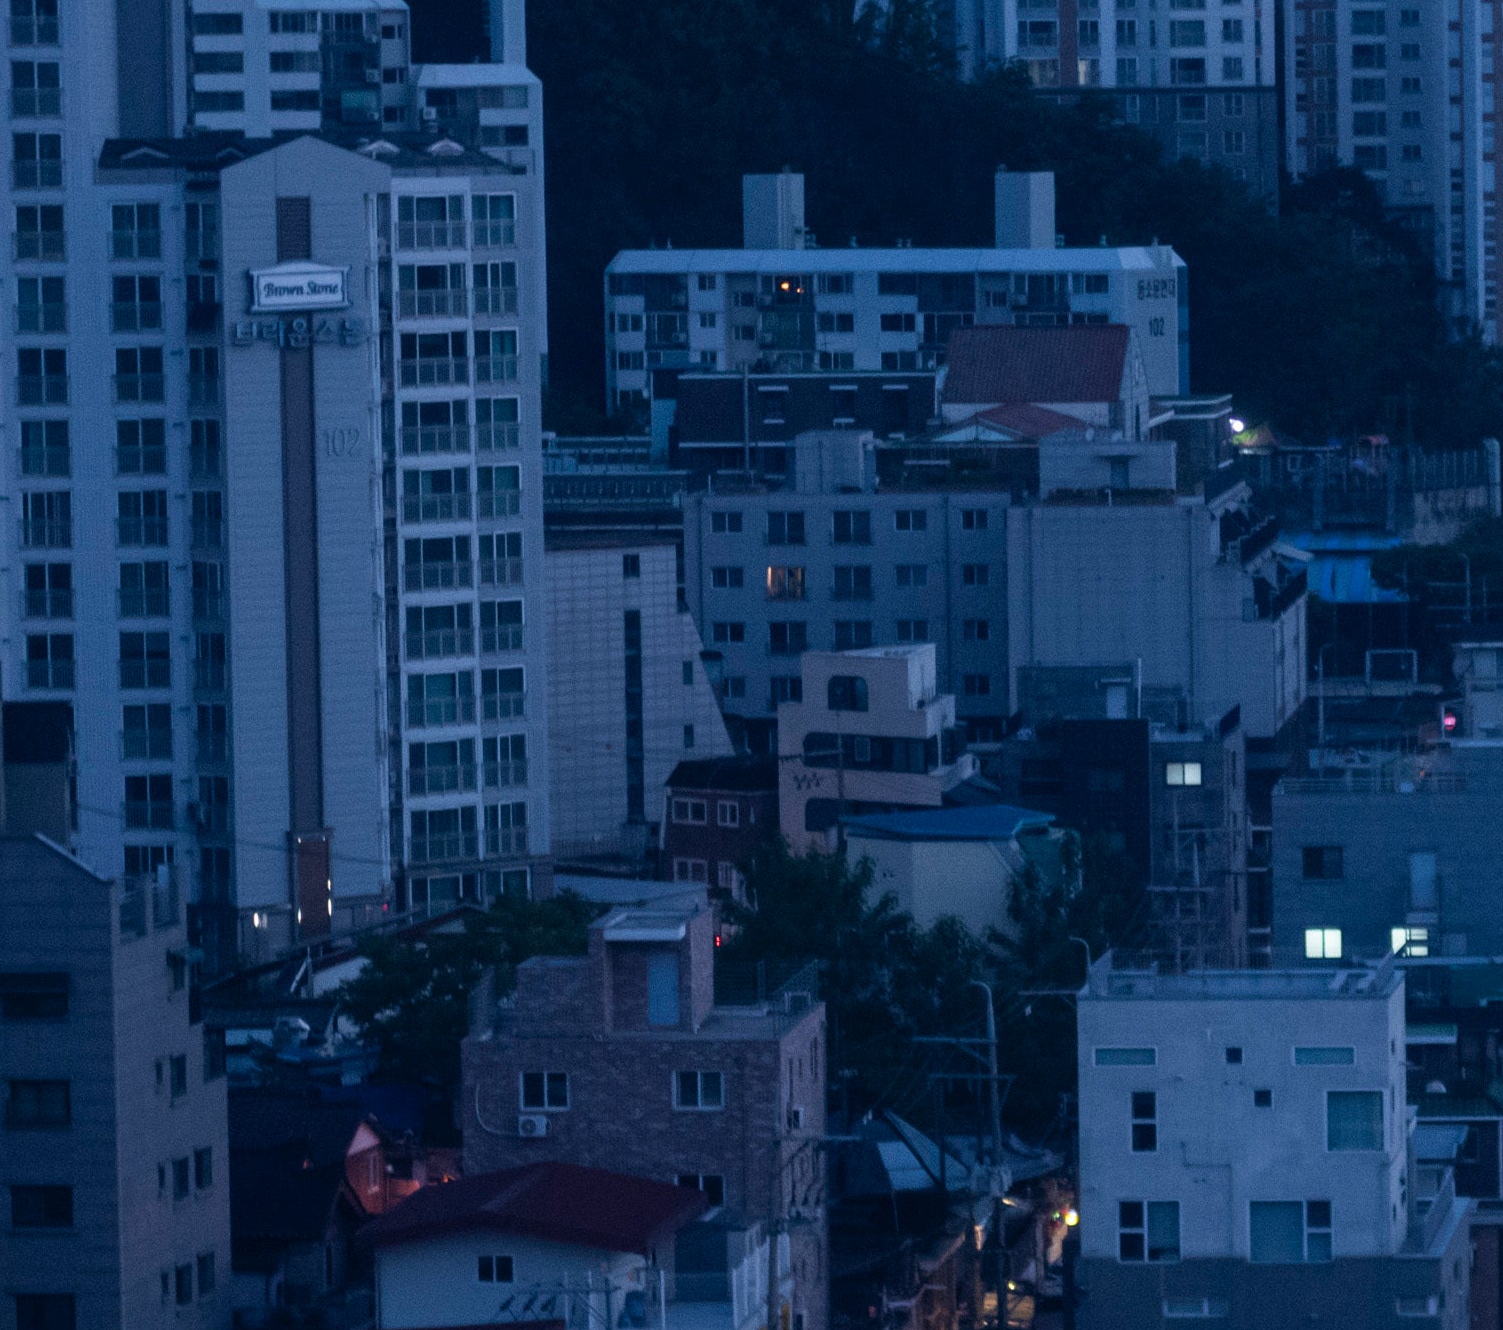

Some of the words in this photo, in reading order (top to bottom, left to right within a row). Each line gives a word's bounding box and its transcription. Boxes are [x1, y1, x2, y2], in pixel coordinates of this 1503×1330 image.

[264, 282, 303, 298] Brown
[306, 280, 340, 295] Stone
[1149, 317, 1165, 336] 102
[324, 428, 359, 459] 102
